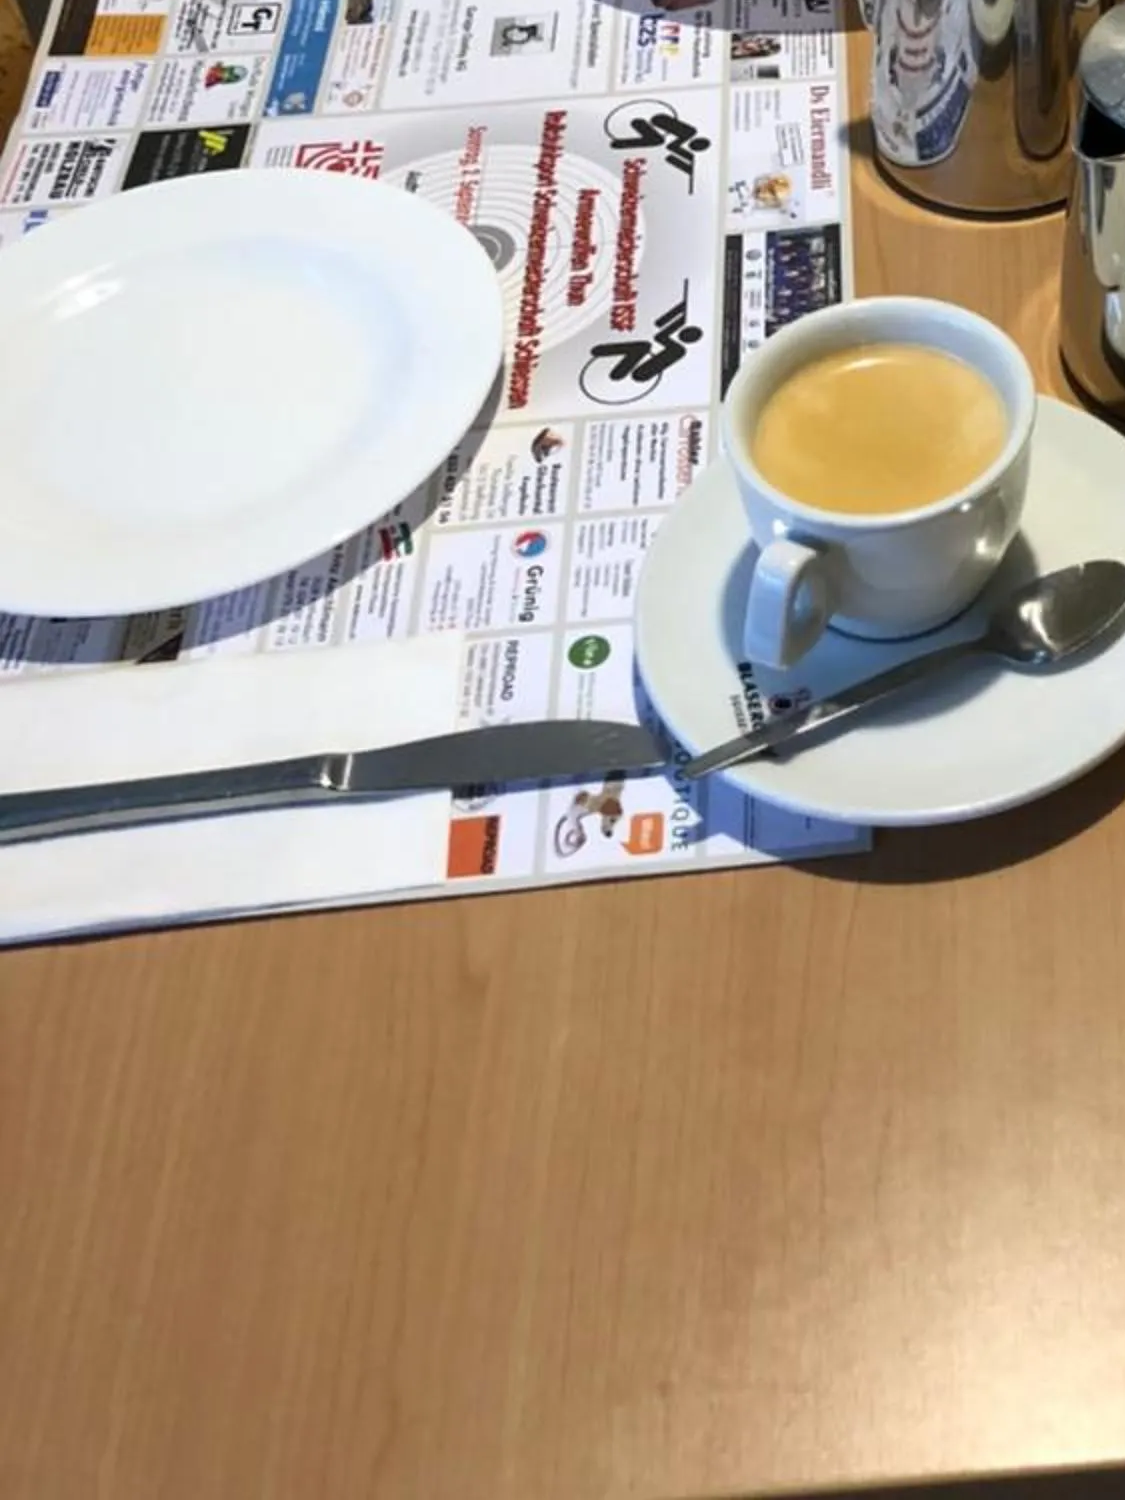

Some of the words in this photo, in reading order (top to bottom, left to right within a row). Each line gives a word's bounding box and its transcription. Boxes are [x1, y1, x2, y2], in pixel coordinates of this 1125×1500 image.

[810, 85, 829, 103] Ds
[518, 189, 556, 336] Schweizermeisterschaft
[571, 188, 599, 271] Armeewaffen
[613, 158, 645, 301] Schweizermeisterschaft
[567, 272, 592, 306] Thun
[610, 303, 635, 331] ISSF
[508, 339, 539, 409] Schiessen
[519, 565, 543, 621] Grünig
[671, 750, 692, 853] OUTIQUE
